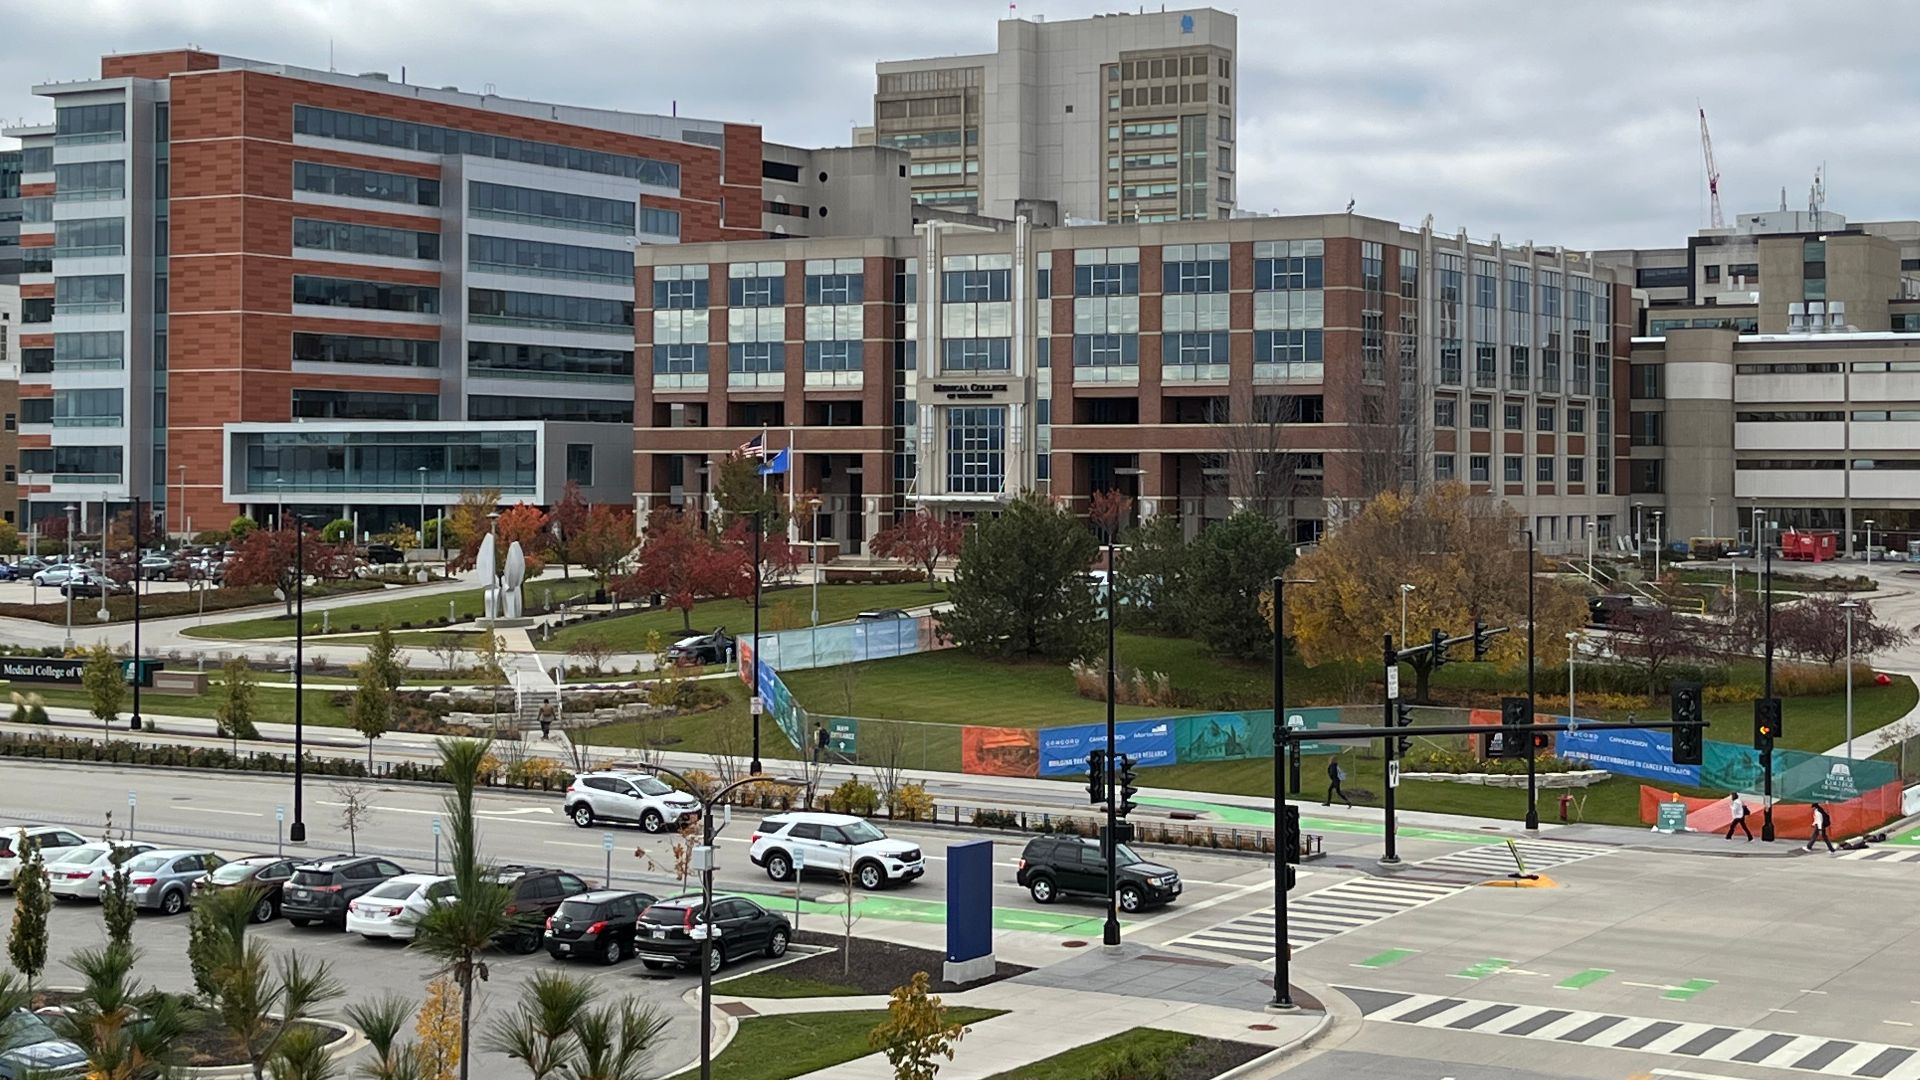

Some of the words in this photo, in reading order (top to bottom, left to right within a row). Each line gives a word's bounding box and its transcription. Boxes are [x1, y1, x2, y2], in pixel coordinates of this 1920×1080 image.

[4, 664, 34, 676] Medical
[35, 665, 65, 679] College
[66, 666, 75, 677] of
[1045, 738, 1080, 746] CONCORD
[1142, 750, 1168, 758] RESEARCH
[1642, 761, 1663, 770] CANCER
[1663, 765, 1691, 776] RESEARCH
